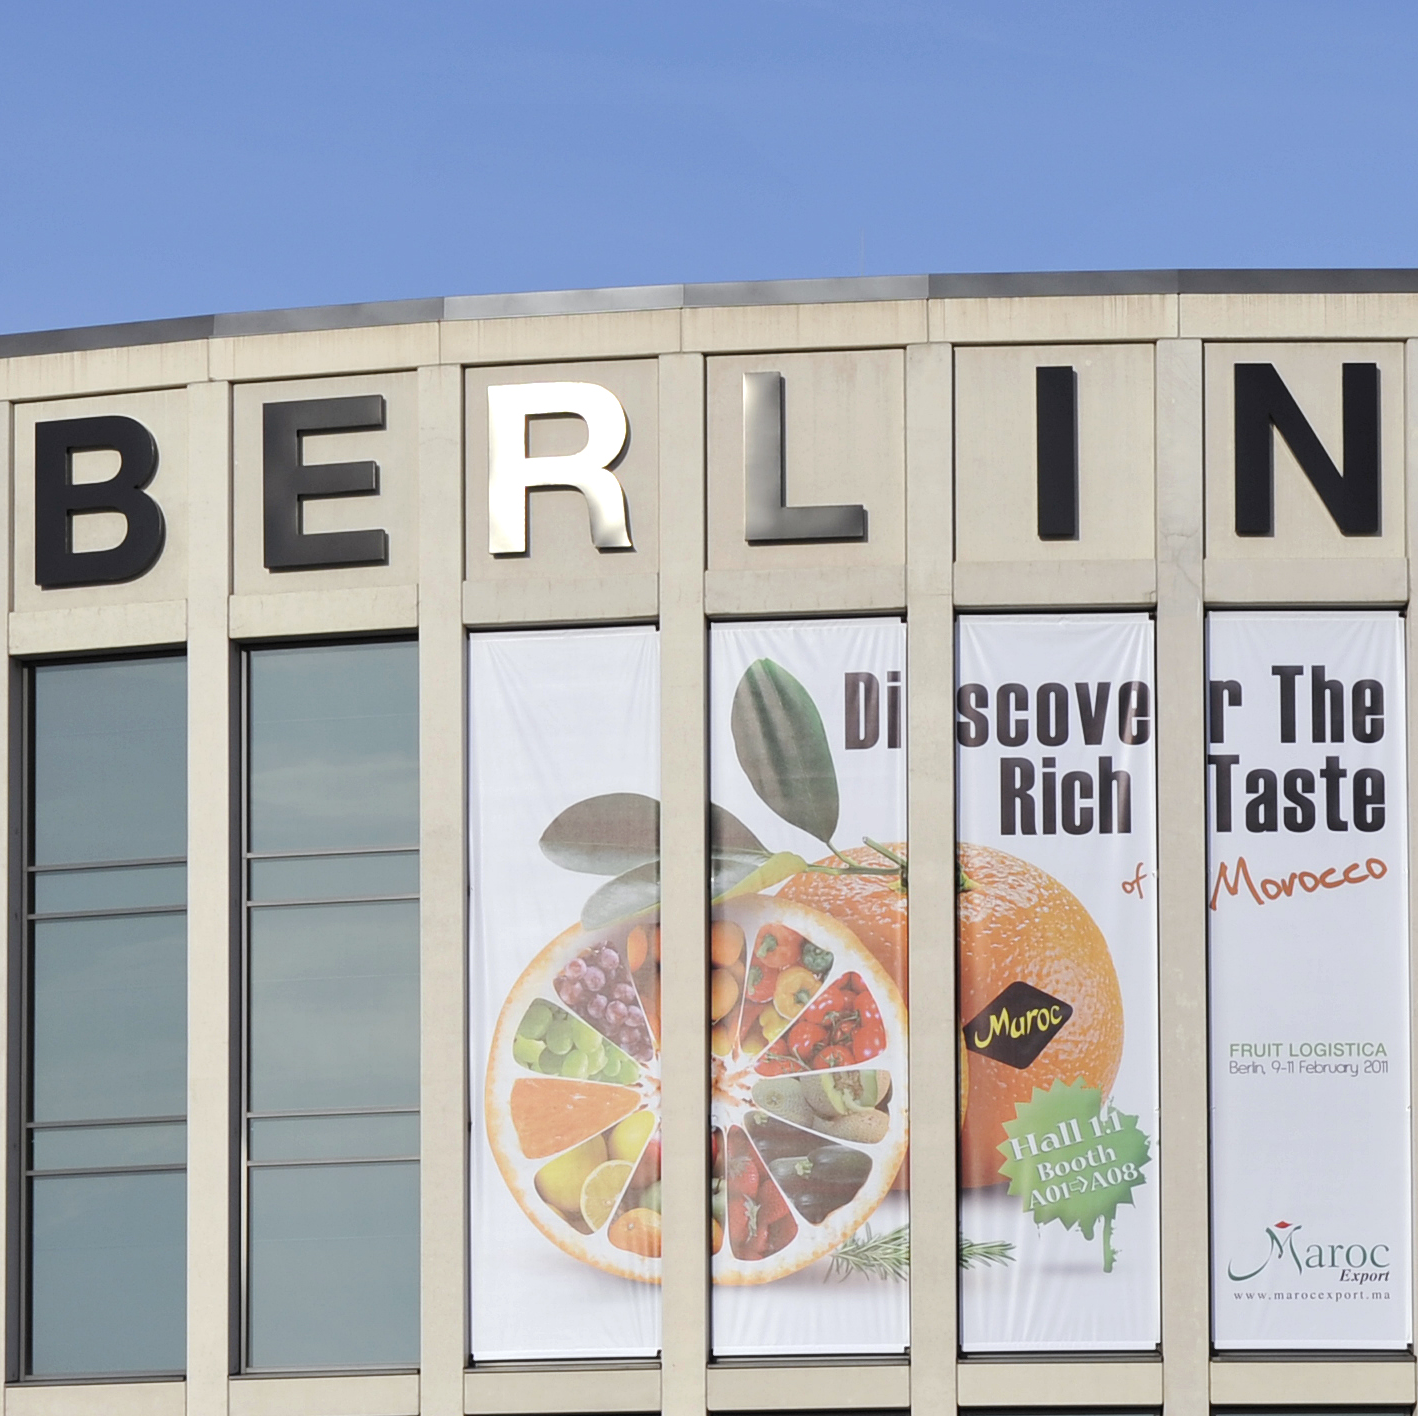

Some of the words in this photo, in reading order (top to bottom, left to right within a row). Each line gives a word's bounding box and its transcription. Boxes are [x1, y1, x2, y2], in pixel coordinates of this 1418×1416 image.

[34, 362, 1380, 588] BERLIN
[1272, 665, 1385, 743] The
[1000, 756, 1132, 835] Rich
[1207, 754, 1386, 833] Taste
[1122, 862, 1147, 899] of
[1209, 856, 1388, 911] Morocco
[1229, 1060, 1266, 1075] Berlin,
[1271, 1060, 1294, 1074] 9-11
[1299, 1060, 1359, 1077] February
[1364, 1060, 1389, 1074] 2011
[1230, 1043, 1284, 1058] FRUIT
[1289, 1042, 1388, 1058] LOGISTICA
[1009, 1118, 1084, 1162] Hall
[1088, 1110, 1125, 1139] 1.1
[1037, 1144, 1117, 1182] Booth
[1227, 1224, 1391, 1282] Maroc
[1339, 1268, 1391, 1285] Export
[1234, 1291, 1391, 1302] www.marocexport.ma
